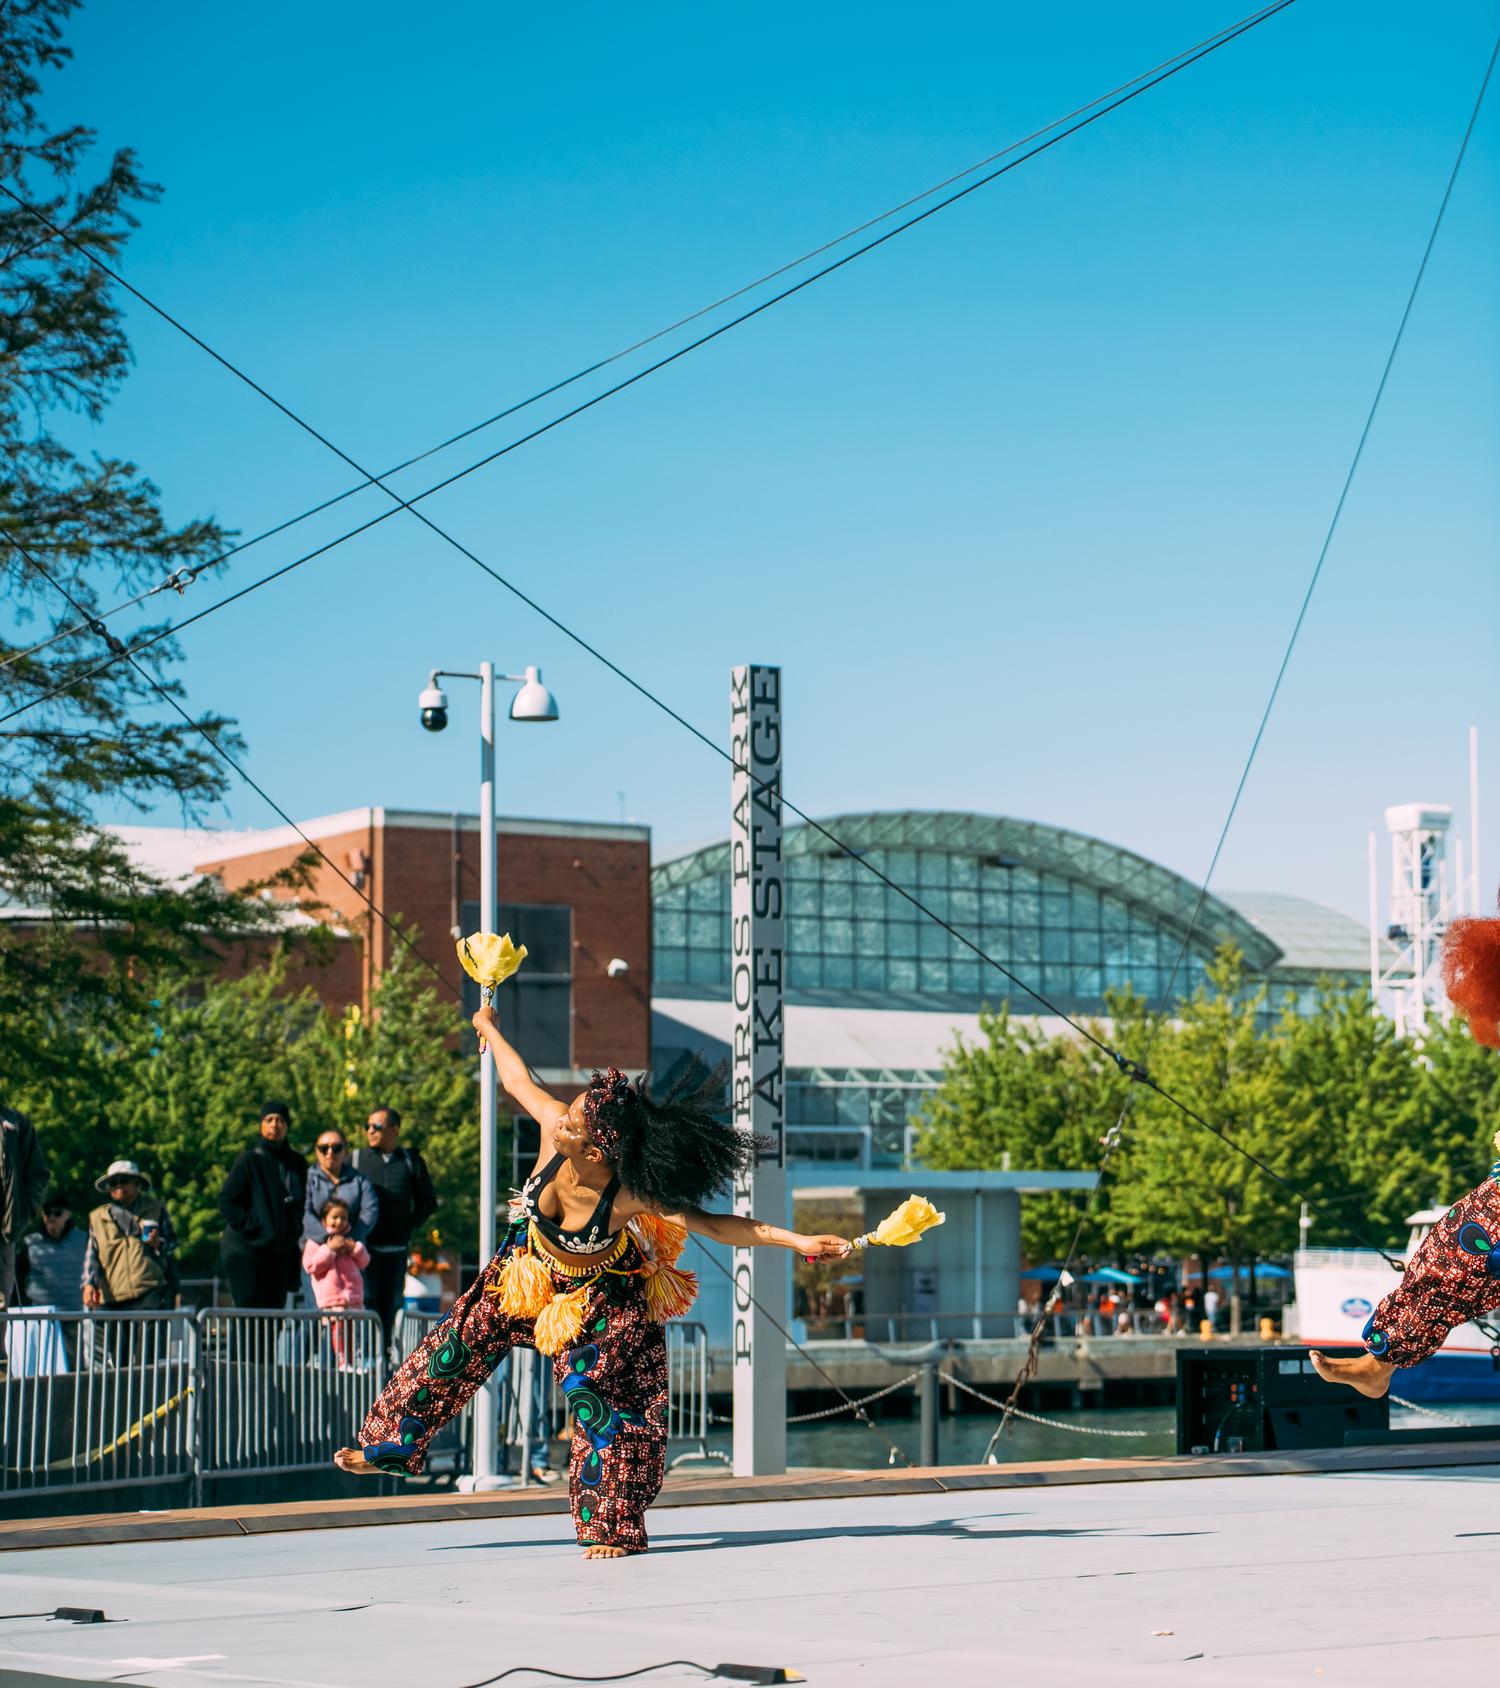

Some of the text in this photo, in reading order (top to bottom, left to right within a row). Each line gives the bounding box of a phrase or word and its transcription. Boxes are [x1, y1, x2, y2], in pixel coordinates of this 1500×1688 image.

[731, 670, 750, 888] PARK
[733, 914, 751, 1123] BROS
[750, 666, 783, 1168] LAKE STAGE
